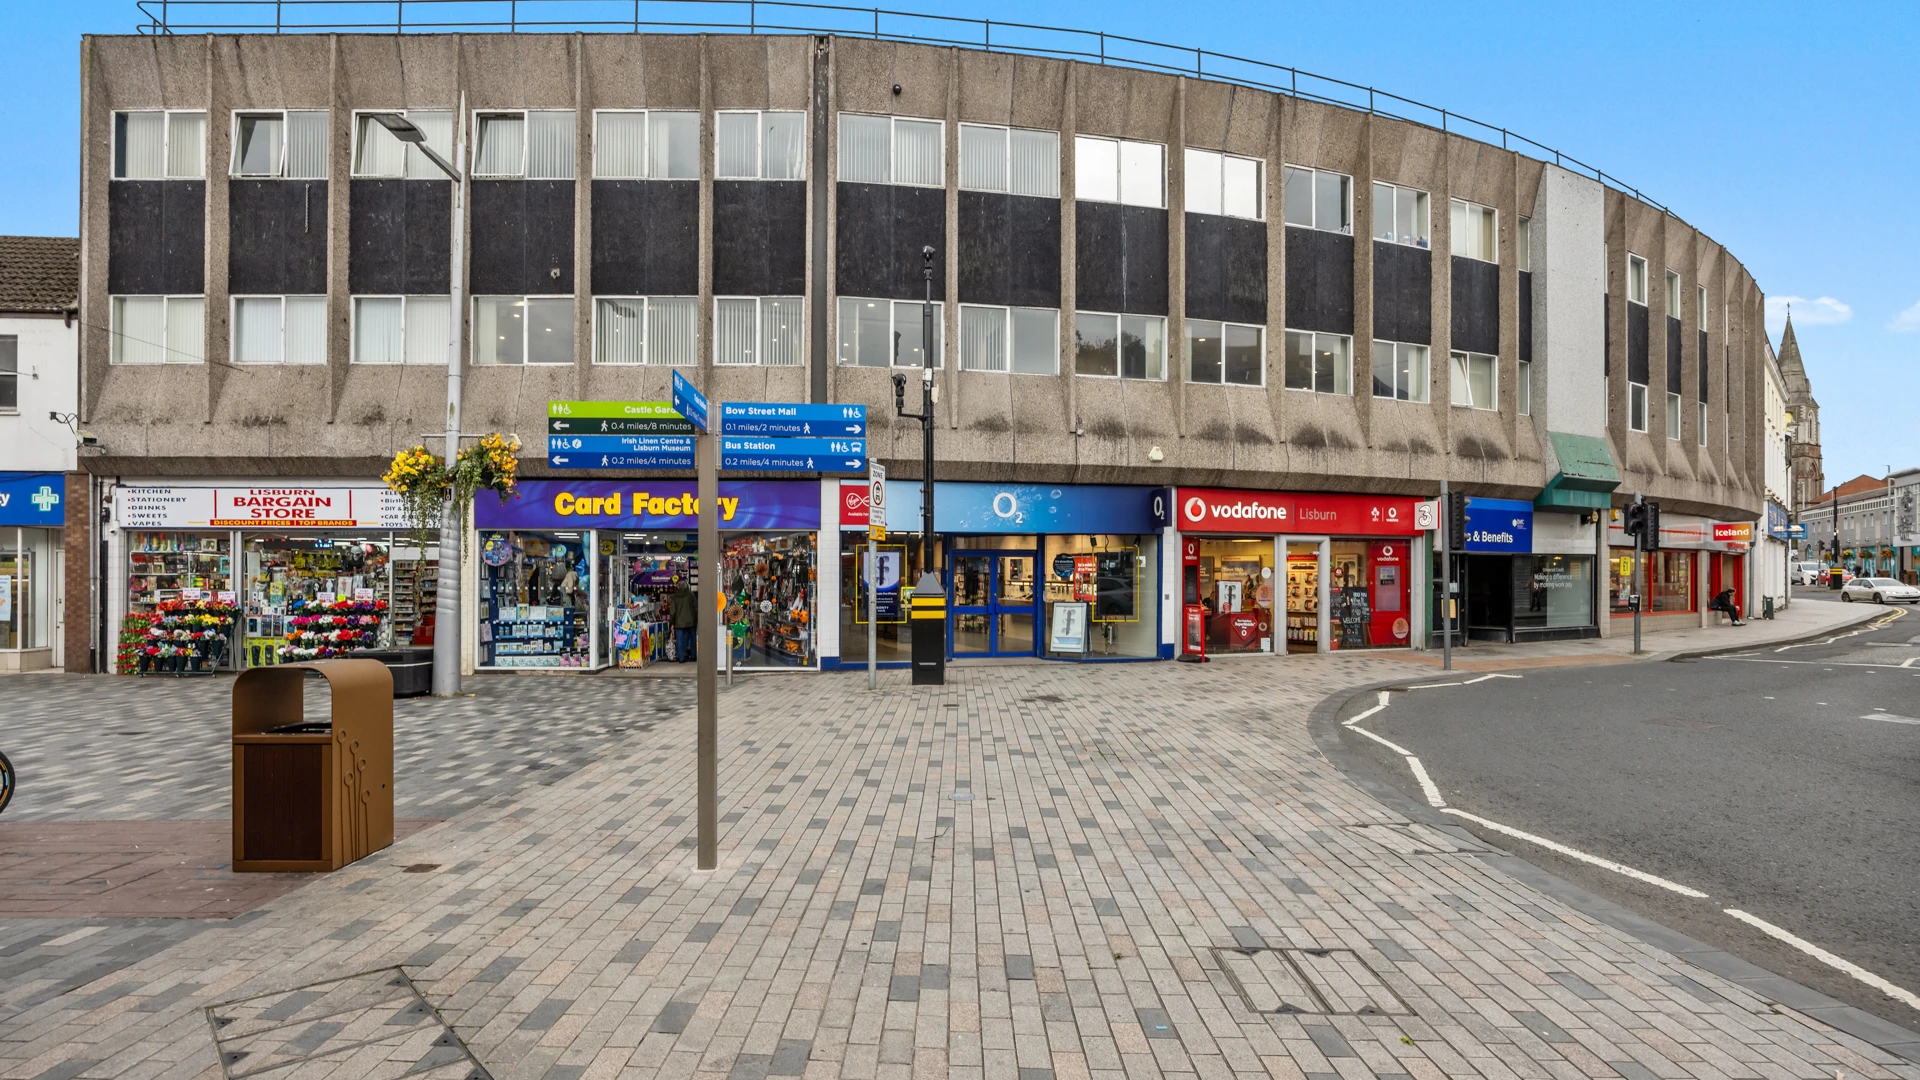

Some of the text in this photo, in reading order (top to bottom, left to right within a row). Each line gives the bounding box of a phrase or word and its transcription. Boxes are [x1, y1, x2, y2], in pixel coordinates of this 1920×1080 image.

[624, 406, 653, 414] Castle
[725, 407, 797, 416] Bow Street Mall
[611, 422, 692, 431] 0.4 miles/8 minutes
[738, 423, 768, 432] miles/2
[769, 424, 801, 432] minutes
[744, 442, 776, 450] Station
[626, 456, 657, 465] miles/4
[659, 457, 691, 465] minutes
[725, 458, 804, 467] 0.2 miles/4 minutes
[872, 470, 883, 480] ZONE
[233, 497, 331, 507] BARGAIN
[554, 492, 739, 521] Card Facty
[250, 508, 315, 518] STORE
[1210, 501, 1337, 521] vodafone Lisburn
[1418, 504, 1433, 527] 3
[1473, 530, 1480, 542] &
[1481, 530, 1514, 543] Benefits
[1715, 528, 1749, 537] Iceland
[1533, 582, 1539, 590] by
[1540, 581, 1555, 590] making
[1565, 582, 1573, 590] pay
